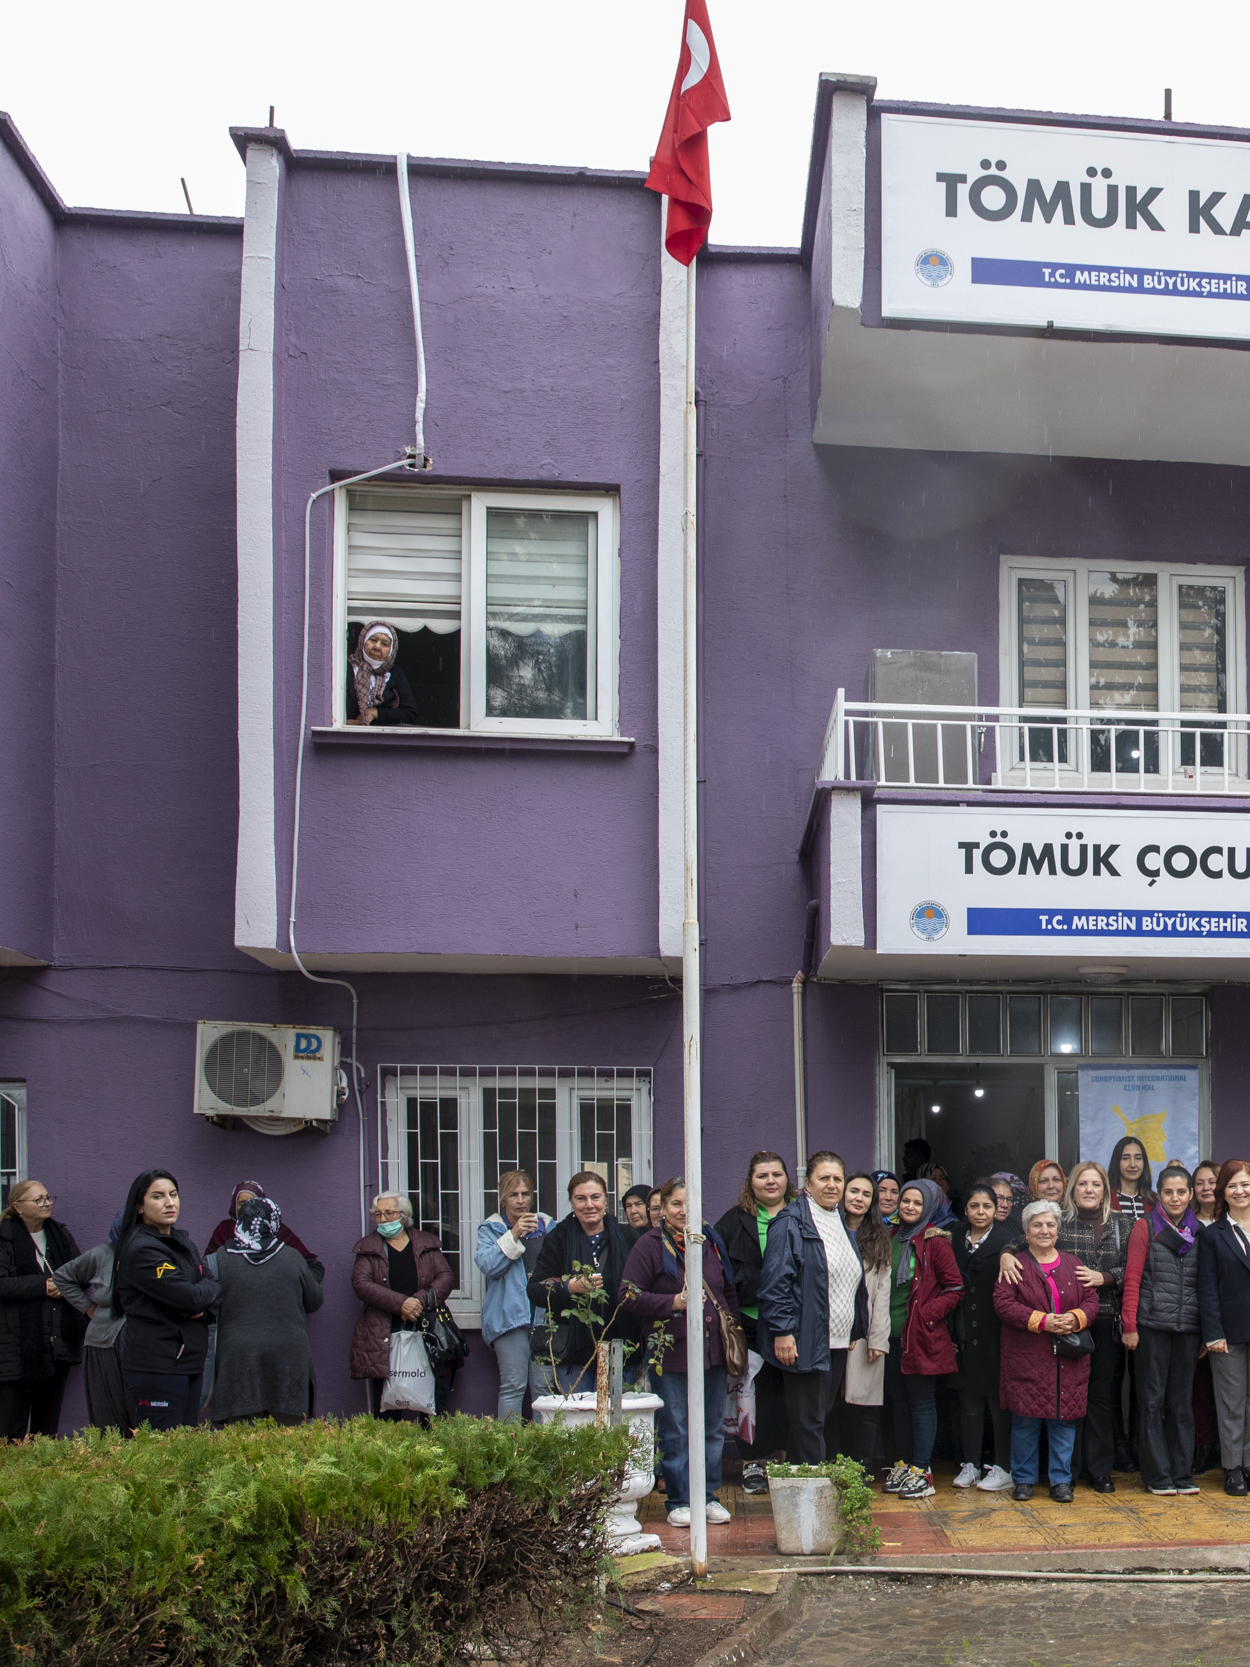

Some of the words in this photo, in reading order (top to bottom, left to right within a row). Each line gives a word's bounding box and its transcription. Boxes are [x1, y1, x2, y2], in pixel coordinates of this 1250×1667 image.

[936, 158, 1165, 232] TÖMÜK
[1042, 267, 1070, 284] T.C.
[1074, 270, 1138, 288] MERSİN
[1143, 272, 1248, 297] BÜYÜKŞEHİR
[957, 829, 1122, 877] TÖMÜK
[1039, 915, 1068, 930] T.C.
[1071, 912, 1136, 931] MERSİN
[1142, 912, 1248, 936] BÜYÜKŞEHİR
[1136, 1074, 1187, 1082] INTERNATIONAL
